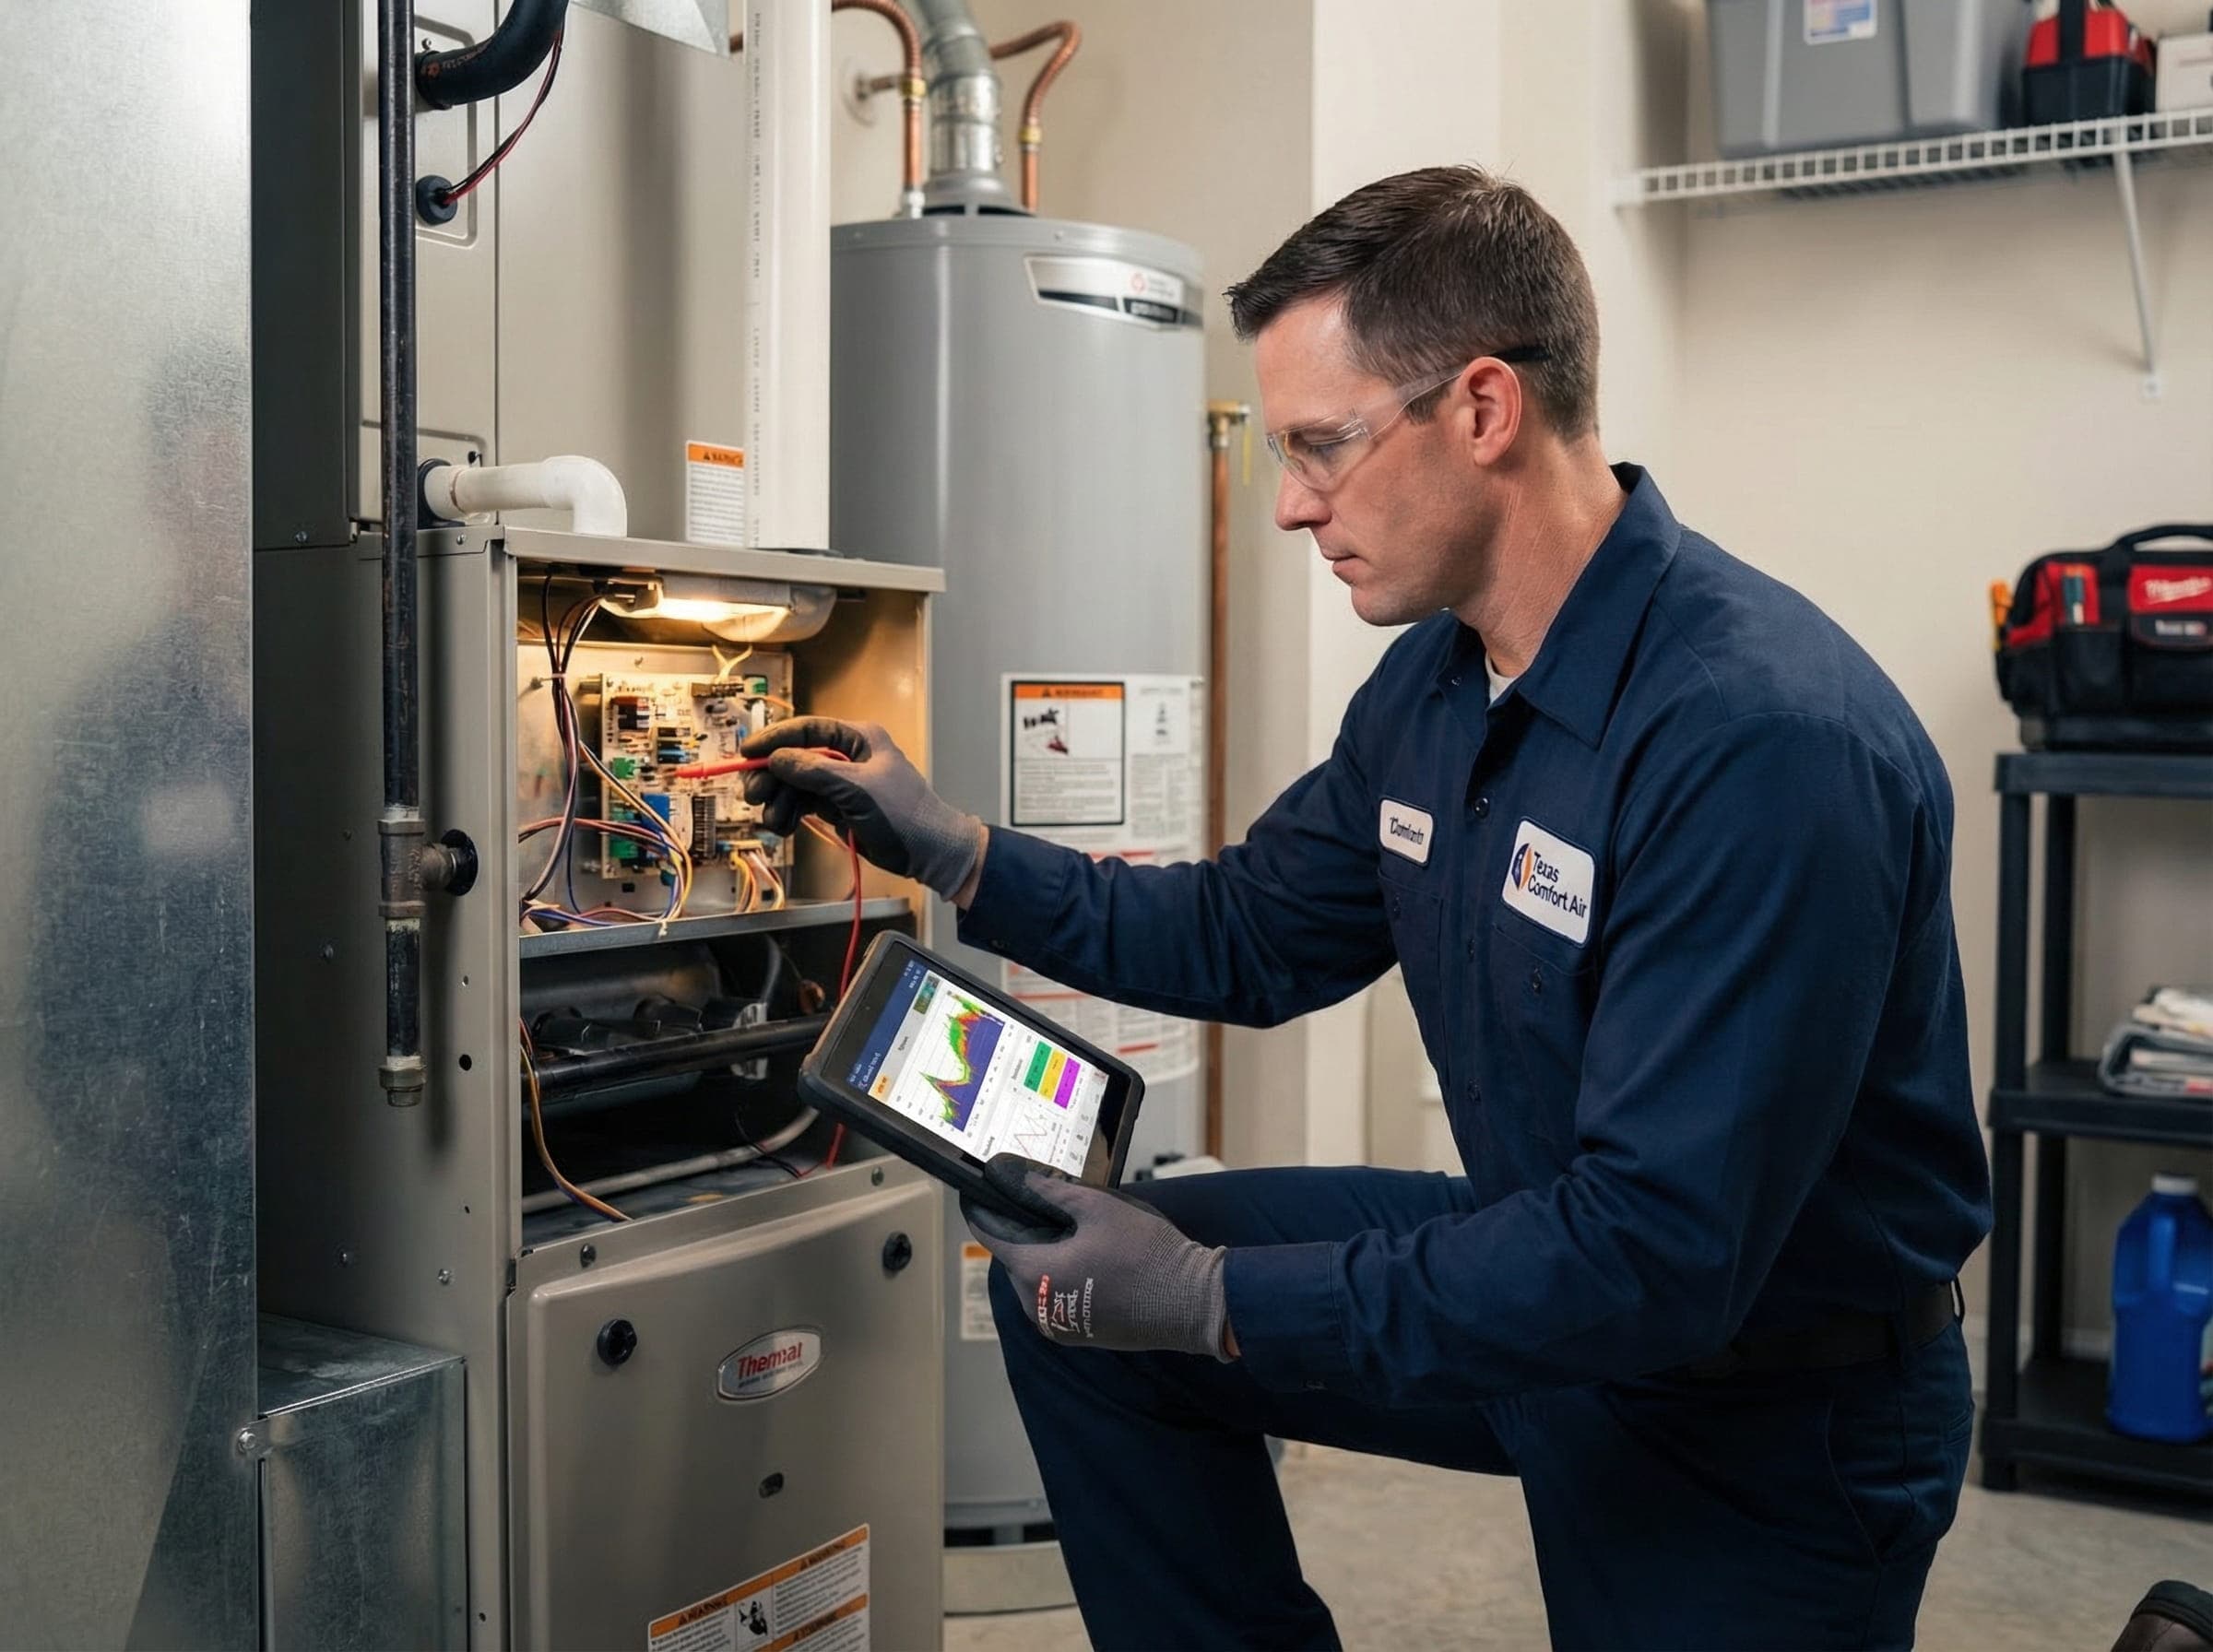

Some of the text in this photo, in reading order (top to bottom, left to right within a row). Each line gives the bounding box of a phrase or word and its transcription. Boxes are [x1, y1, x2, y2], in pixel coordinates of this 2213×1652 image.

[1533, 852, 1558, 882] Texas
[1527, 875, 1587, 919] Comfort Air
